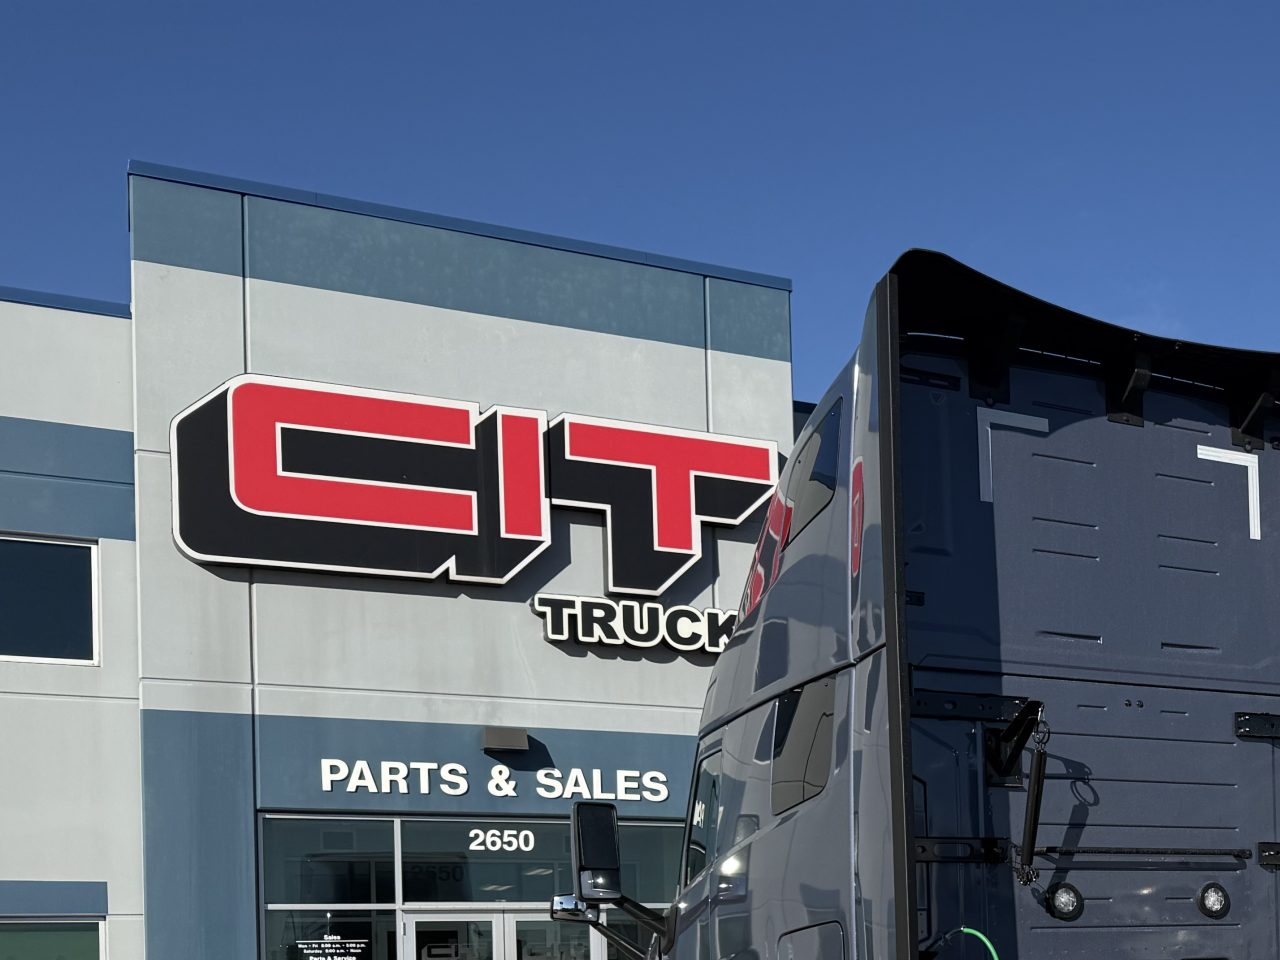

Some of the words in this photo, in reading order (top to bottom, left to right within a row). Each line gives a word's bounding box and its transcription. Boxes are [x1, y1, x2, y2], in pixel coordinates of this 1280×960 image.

[170, 373, 779, 595] CIT
[320, 758, 469, 797] PARTS
[487, 764, 518, 798] &
[535, 768, 669, 803] SALES
[468, 829, 535, 852] 2650
